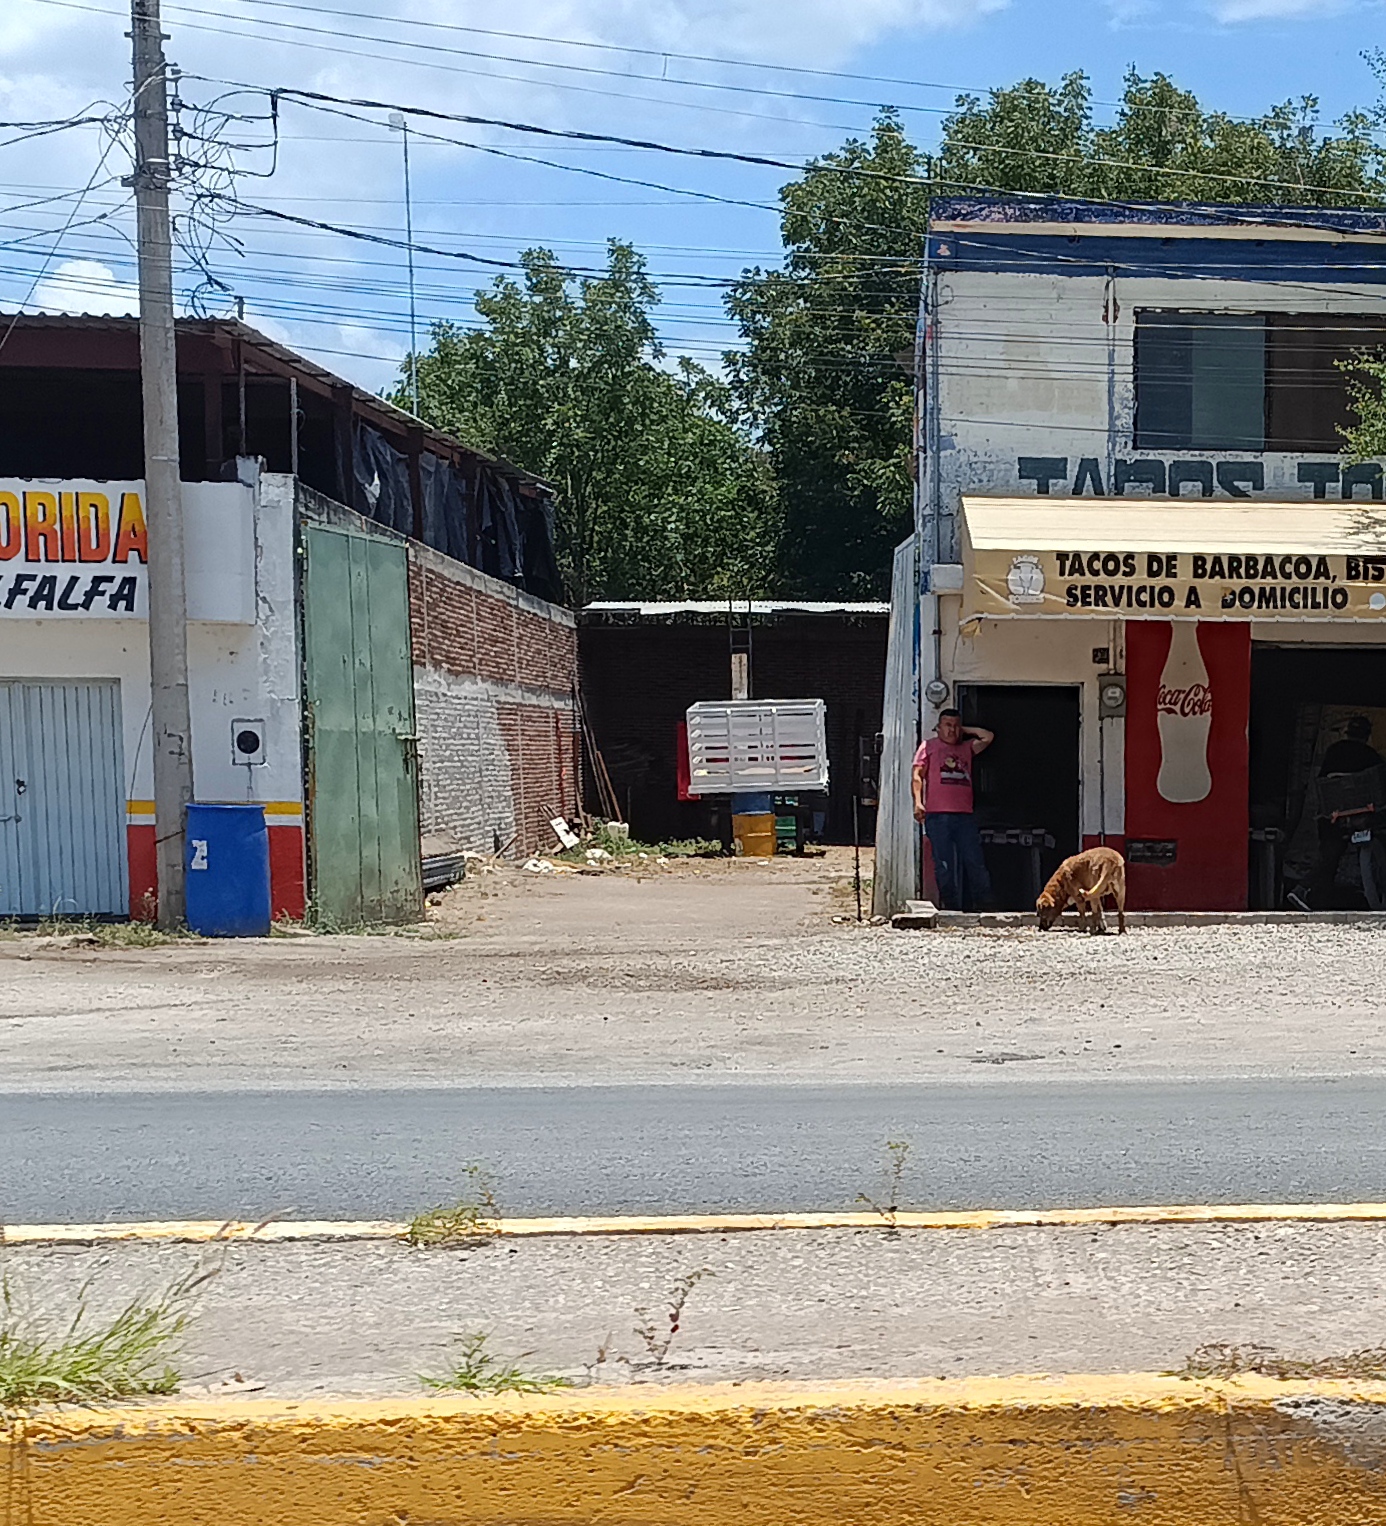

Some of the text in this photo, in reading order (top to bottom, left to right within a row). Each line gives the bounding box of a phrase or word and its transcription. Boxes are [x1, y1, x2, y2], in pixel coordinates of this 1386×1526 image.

[1056, 553, 1136, 577] TACOS
[1146, 554, 1178, 578] DE
[1192, 555, 1338, 583] BARBACOA,
[0, 573, 138, 612] FALFA
[1066, 584, 1175, 608] SERVICIO
[1184, 585, 1202, 608] A
[1221, 585, 1348, 610] DOMICILIO
